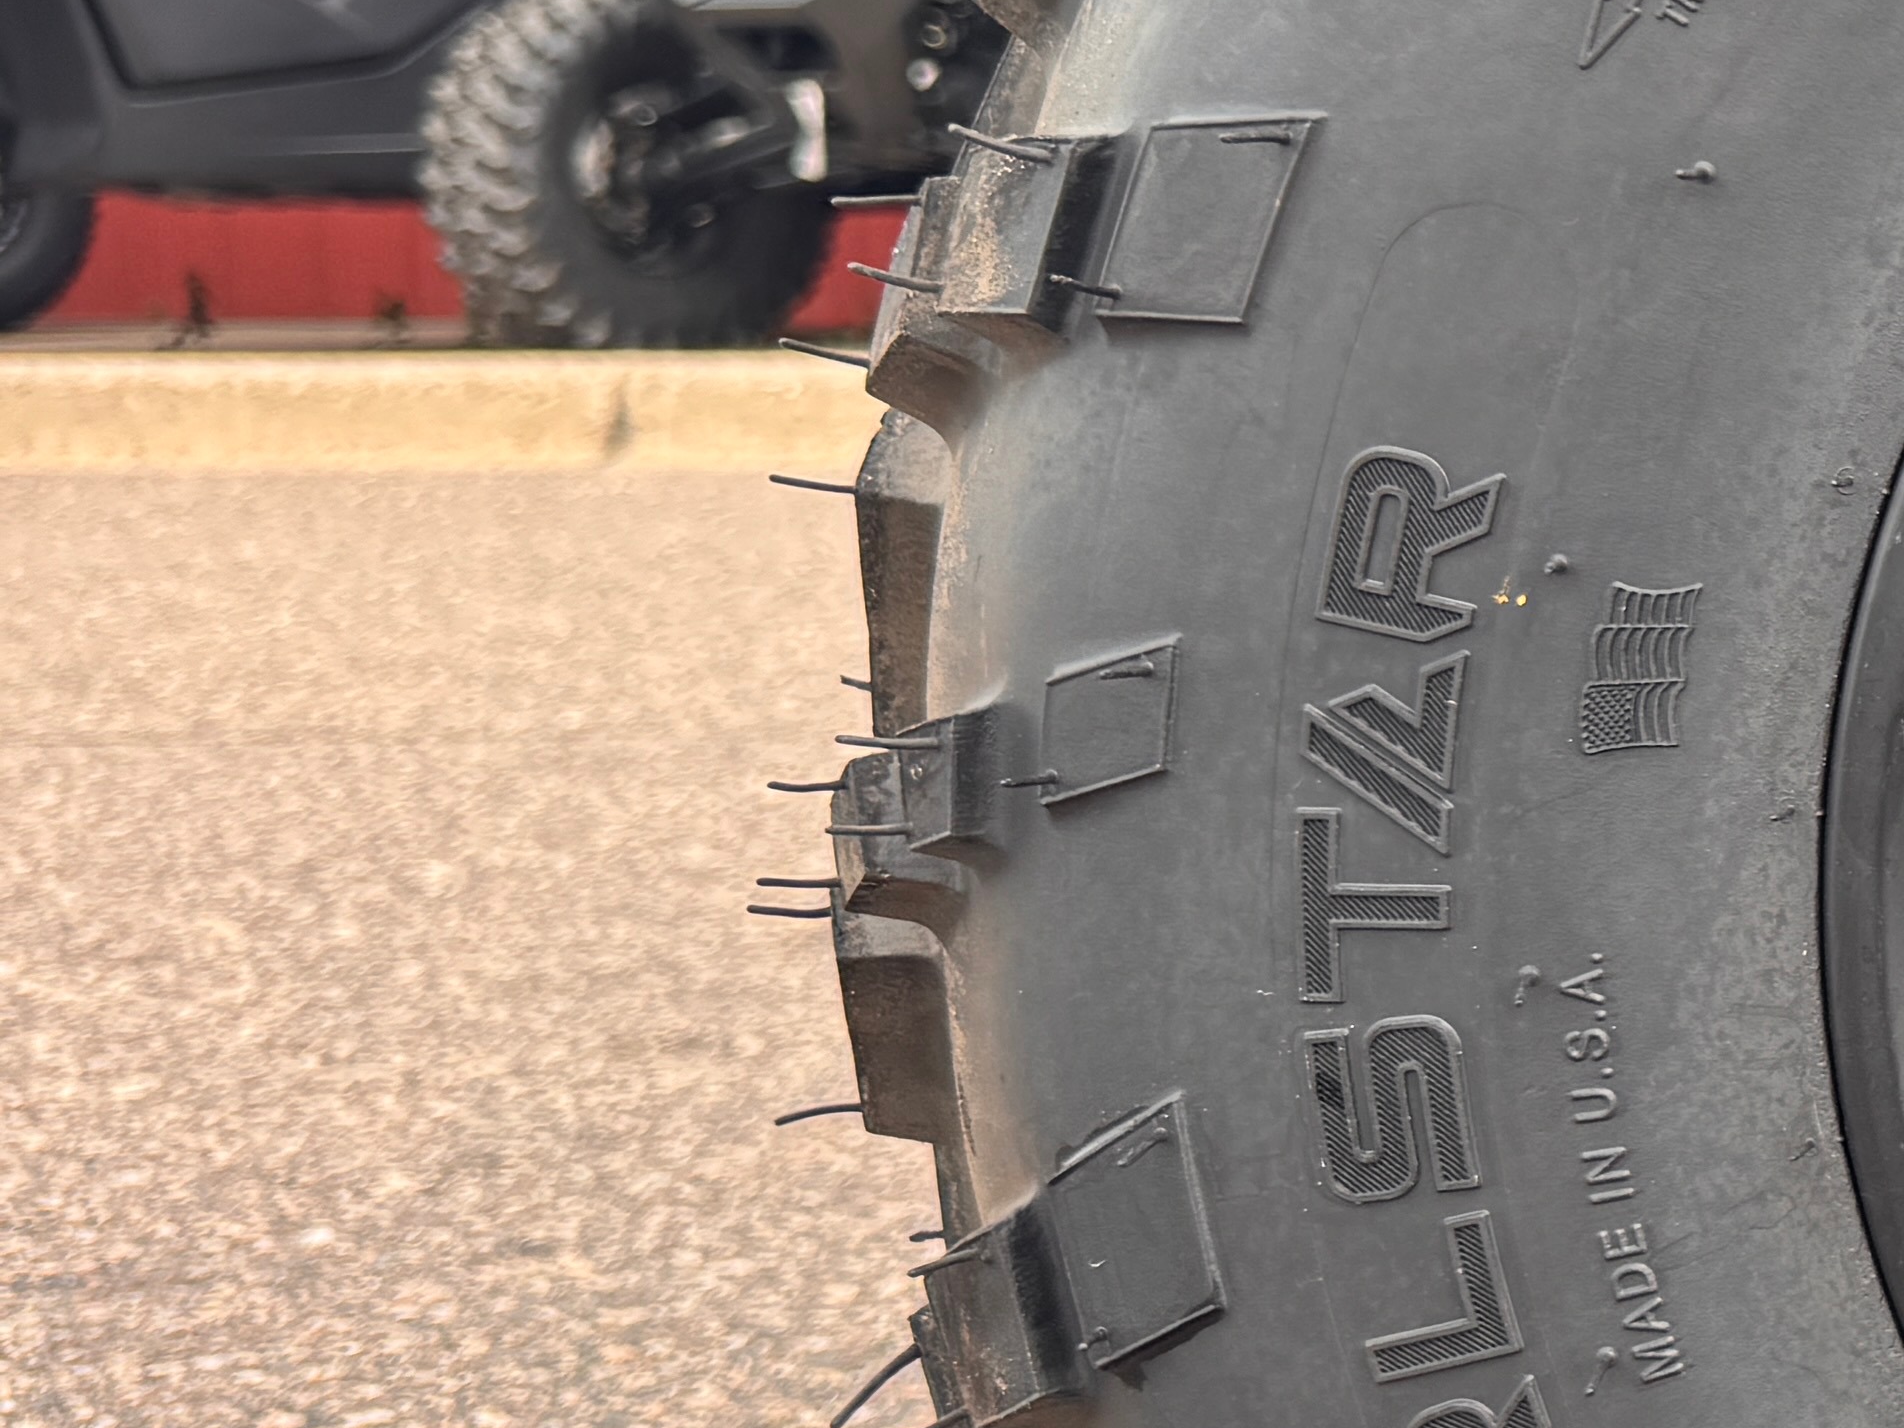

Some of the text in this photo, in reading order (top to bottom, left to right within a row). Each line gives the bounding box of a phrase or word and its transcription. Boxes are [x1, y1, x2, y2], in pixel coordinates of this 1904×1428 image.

[1559, 953, 1685, 1382] MADE IN U.S.A.
